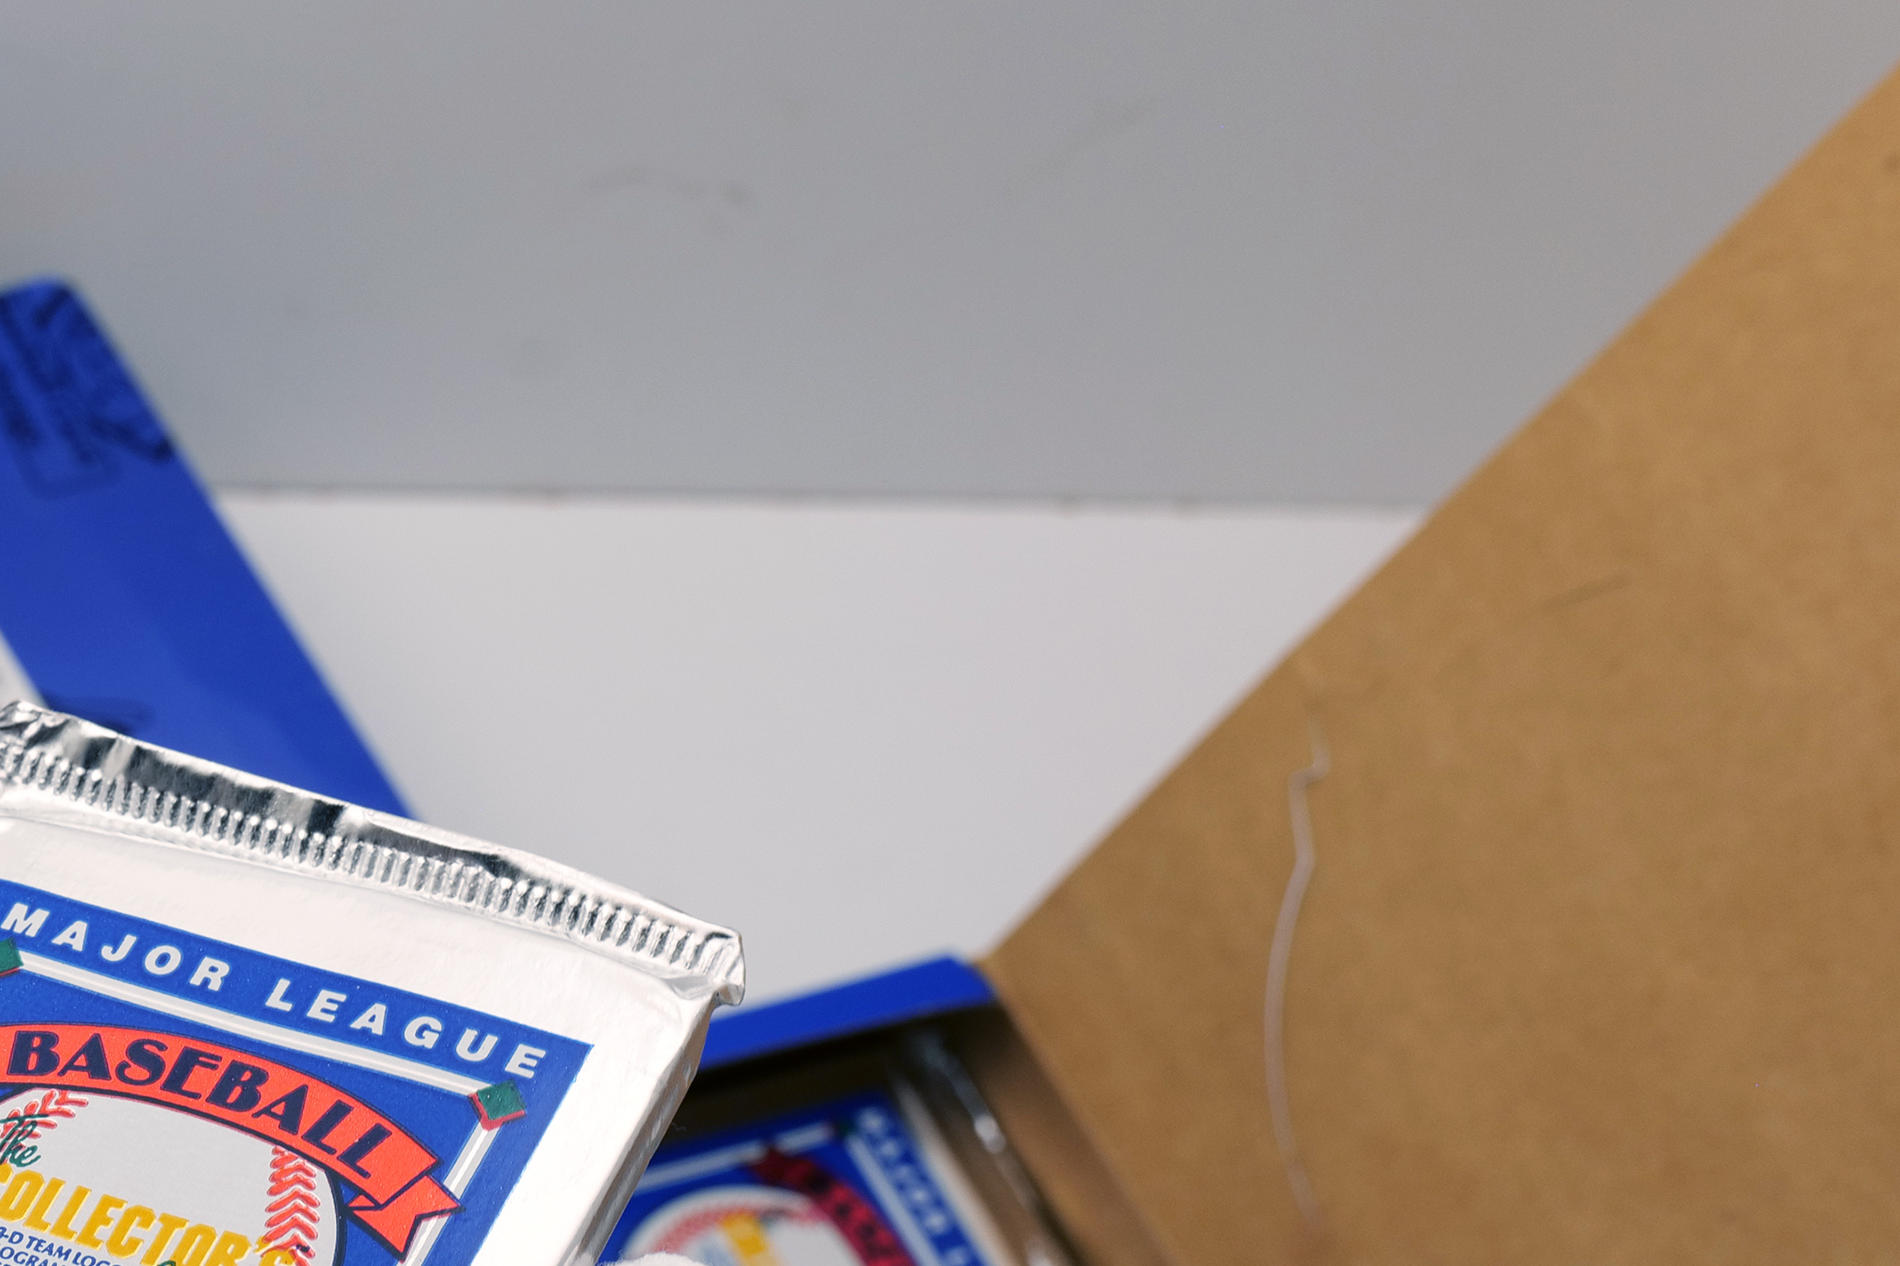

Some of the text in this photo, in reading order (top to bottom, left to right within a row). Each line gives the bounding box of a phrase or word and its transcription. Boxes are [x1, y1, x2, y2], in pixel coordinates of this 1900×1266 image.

[0, 901, 548, 1080] MAJOR LEAGUE
[6, 1029, 394, 1181] BASEBALL
[26, 1235, 71, 1260] TEAM
